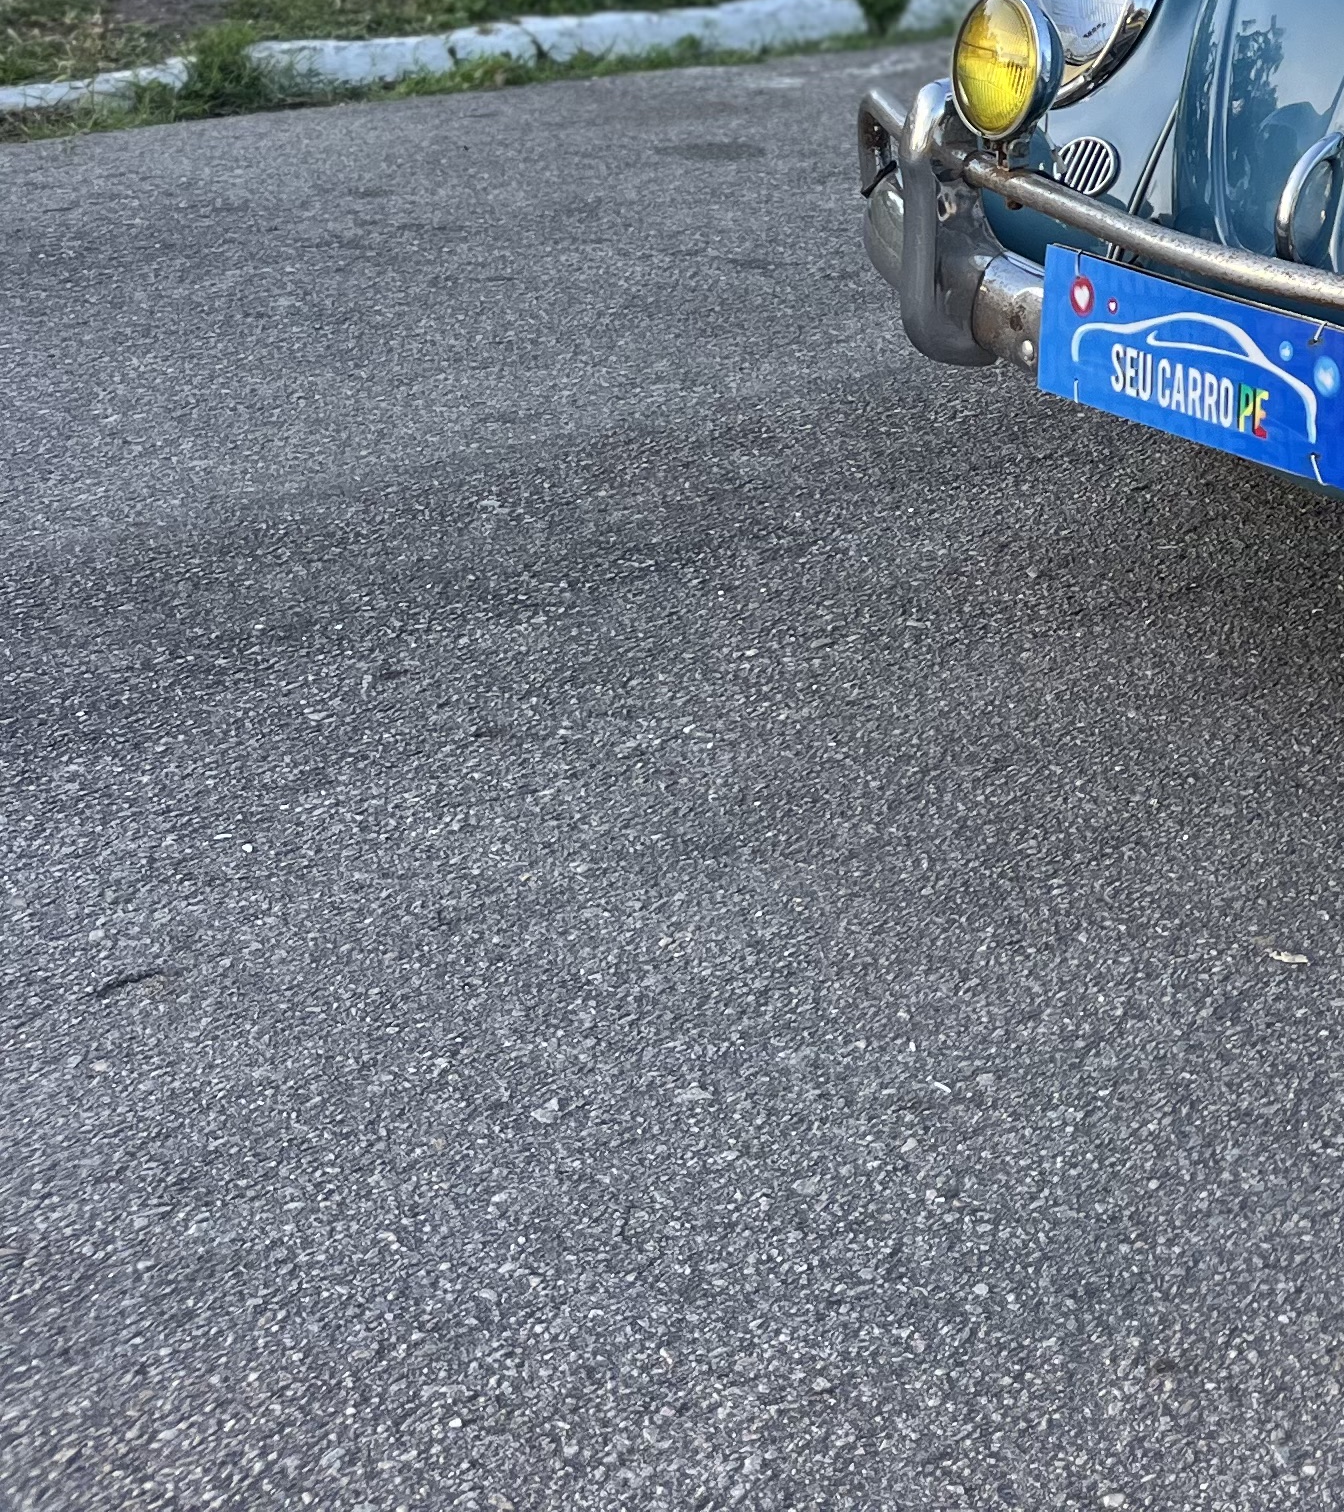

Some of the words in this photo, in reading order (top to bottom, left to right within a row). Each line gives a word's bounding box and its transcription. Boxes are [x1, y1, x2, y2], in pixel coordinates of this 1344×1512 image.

[1111, 343, 1153, 402] SEU
[1157, 358, 1234, 428] CARRO
[1238, 382, 1269, 439] PE
